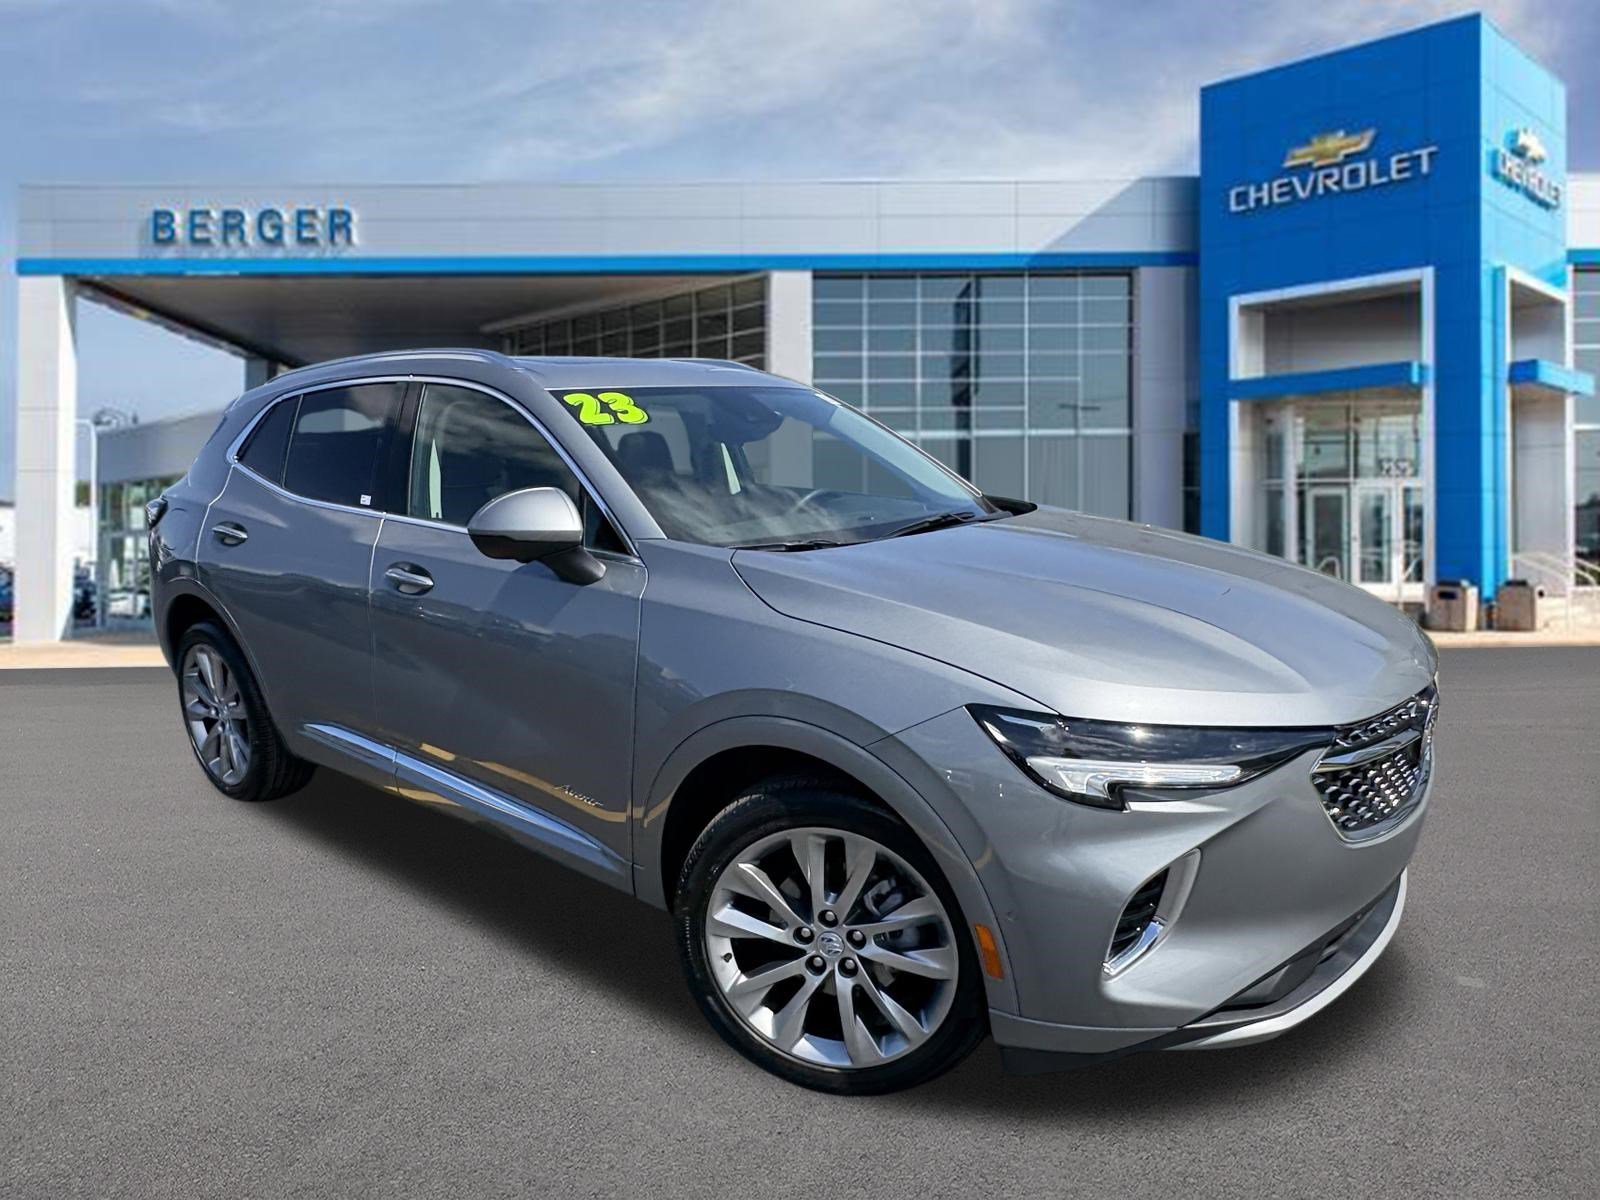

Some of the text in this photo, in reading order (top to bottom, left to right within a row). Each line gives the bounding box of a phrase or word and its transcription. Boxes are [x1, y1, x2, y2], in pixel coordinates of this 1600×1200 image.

[1228, 146, 1438, 212] CHEVROLET
[152, 208, 356, 246] BERGER
[563, 391, 649, 425] 23
